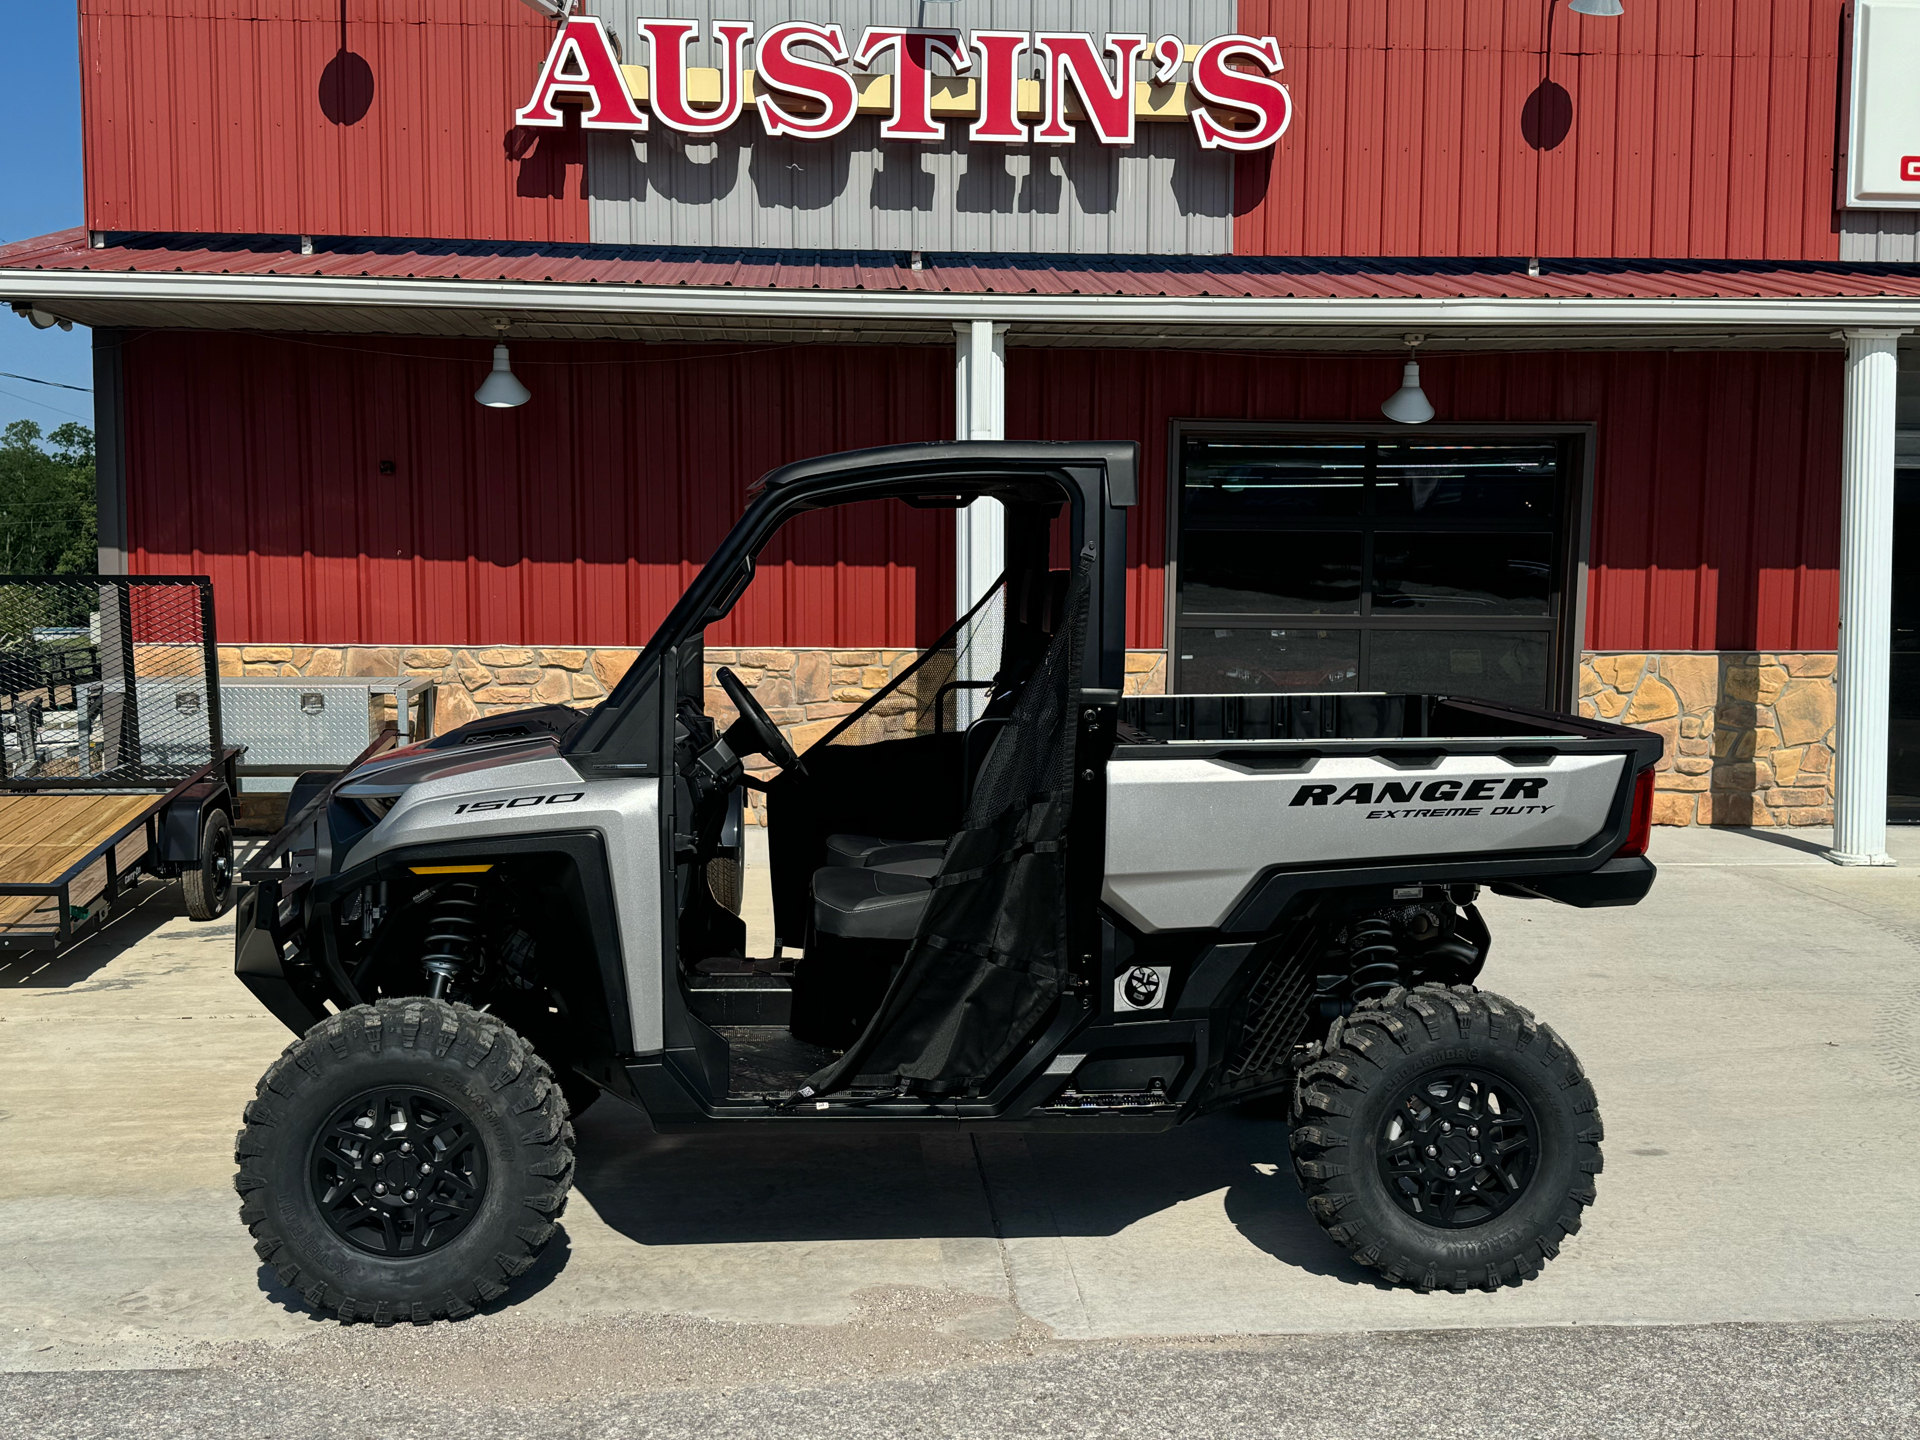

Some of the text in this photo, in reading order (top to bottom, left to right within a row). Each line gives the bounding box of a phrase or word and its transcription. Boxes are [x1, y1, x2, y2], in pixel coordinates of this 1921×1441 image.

[515, 16, 1293, 153] AUSTIN'S
[454, 792, 586, 815] 1500
[1288, 778, 1549, 806] RANGER
[1365, 804, 1556, 819] EXTREME DUTY
[1411, 1047, 1467, 1072] ARMOR
